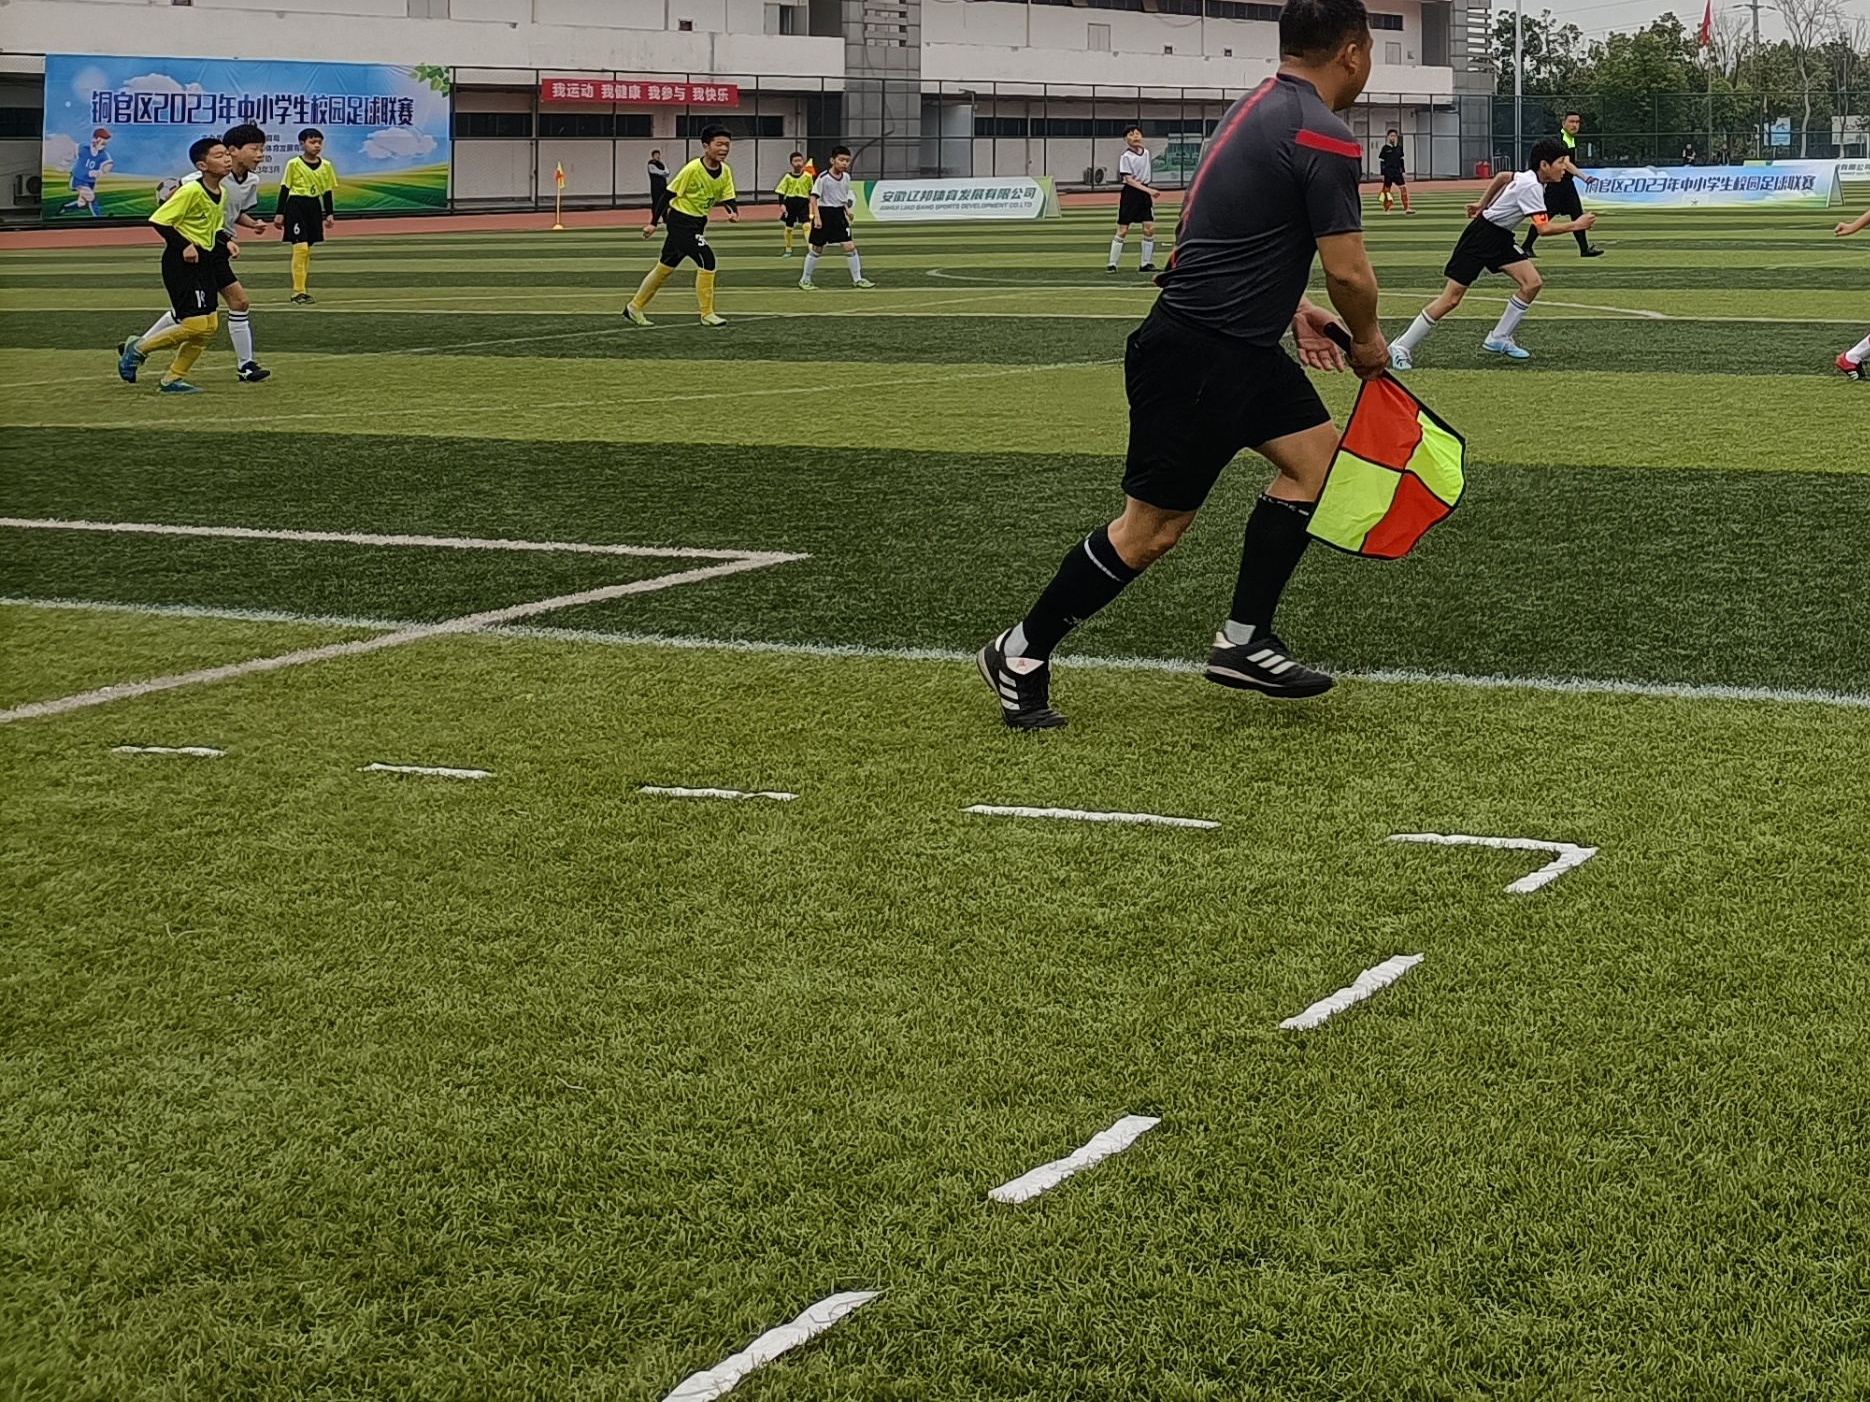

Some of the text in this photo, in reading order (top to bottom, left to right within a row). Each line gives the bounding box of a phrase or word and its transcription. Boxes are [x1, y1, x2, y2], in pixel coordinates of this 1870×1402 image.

[552, 82, 729, 102] 我运动 我健康 我参与 我快乐
[91, 91, 414, 126] 铜官区2023年中小学生校园足球联赛
[85, 158, 96, 169] 10
[310, 184, 316, 195] 6
[881, 187, 1037, 202] 安徽辽邦体育发展有限公司
[293, 223, 300, 235] 6
